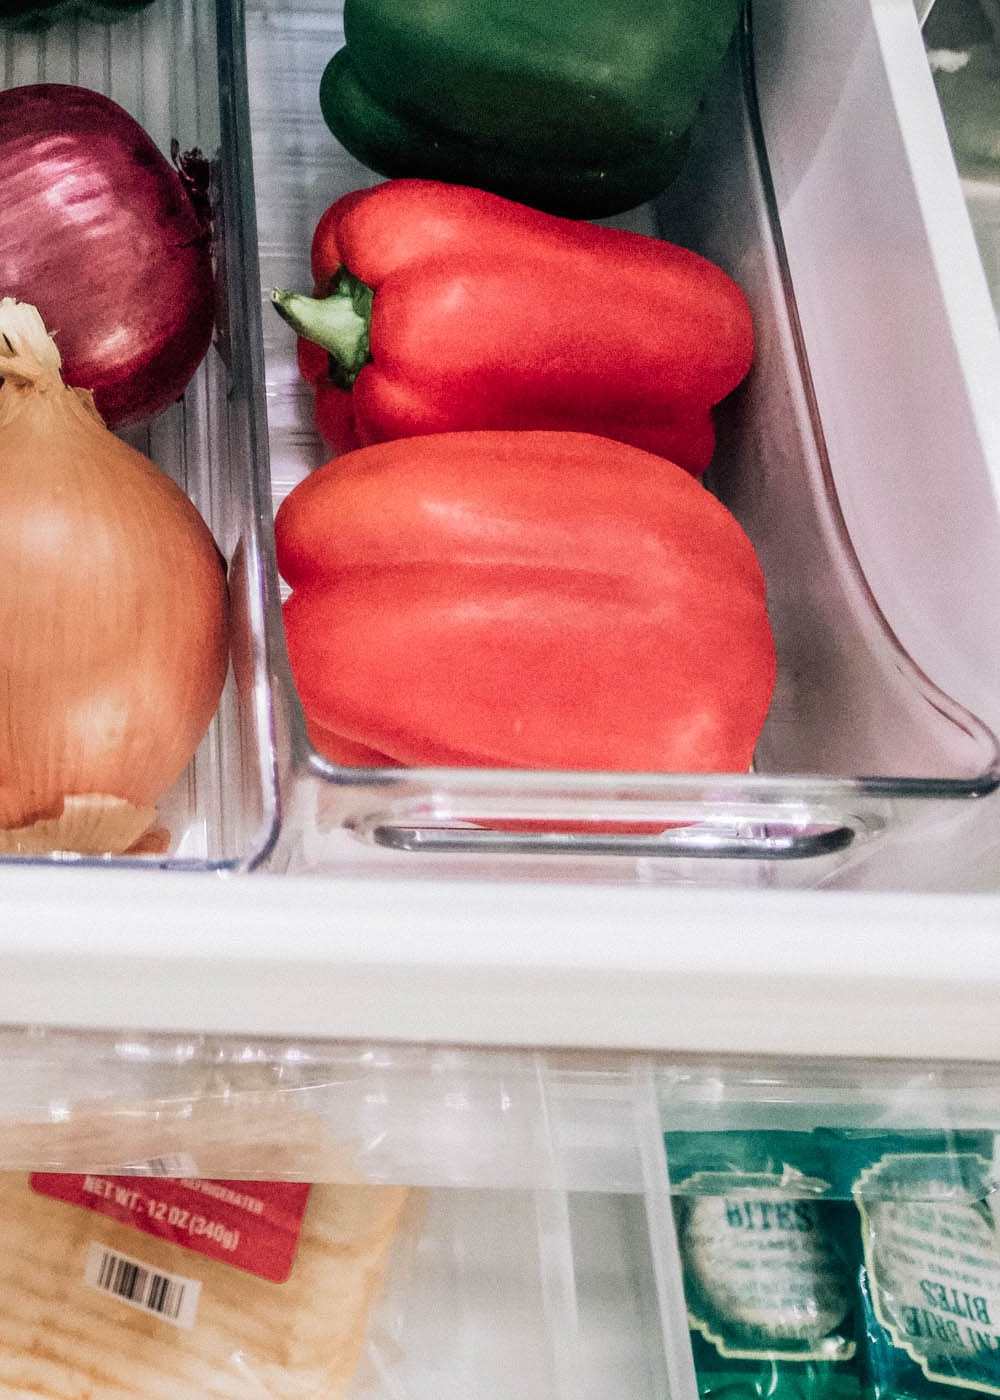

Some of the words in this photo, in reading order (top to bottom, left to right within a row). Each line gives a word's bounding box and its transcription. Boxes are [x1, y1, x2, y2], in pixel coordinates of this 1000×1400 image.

[83, 1175, 114, 1200] NET
[148, 1198, 169, 1221] 12
[168, 1206, 191, 1229] OZ
[189, 1214, 241, 1252] (340g)
[920, 1279, 991, 1325] BITES
[902, 1305, 966, 1349] BRIE
